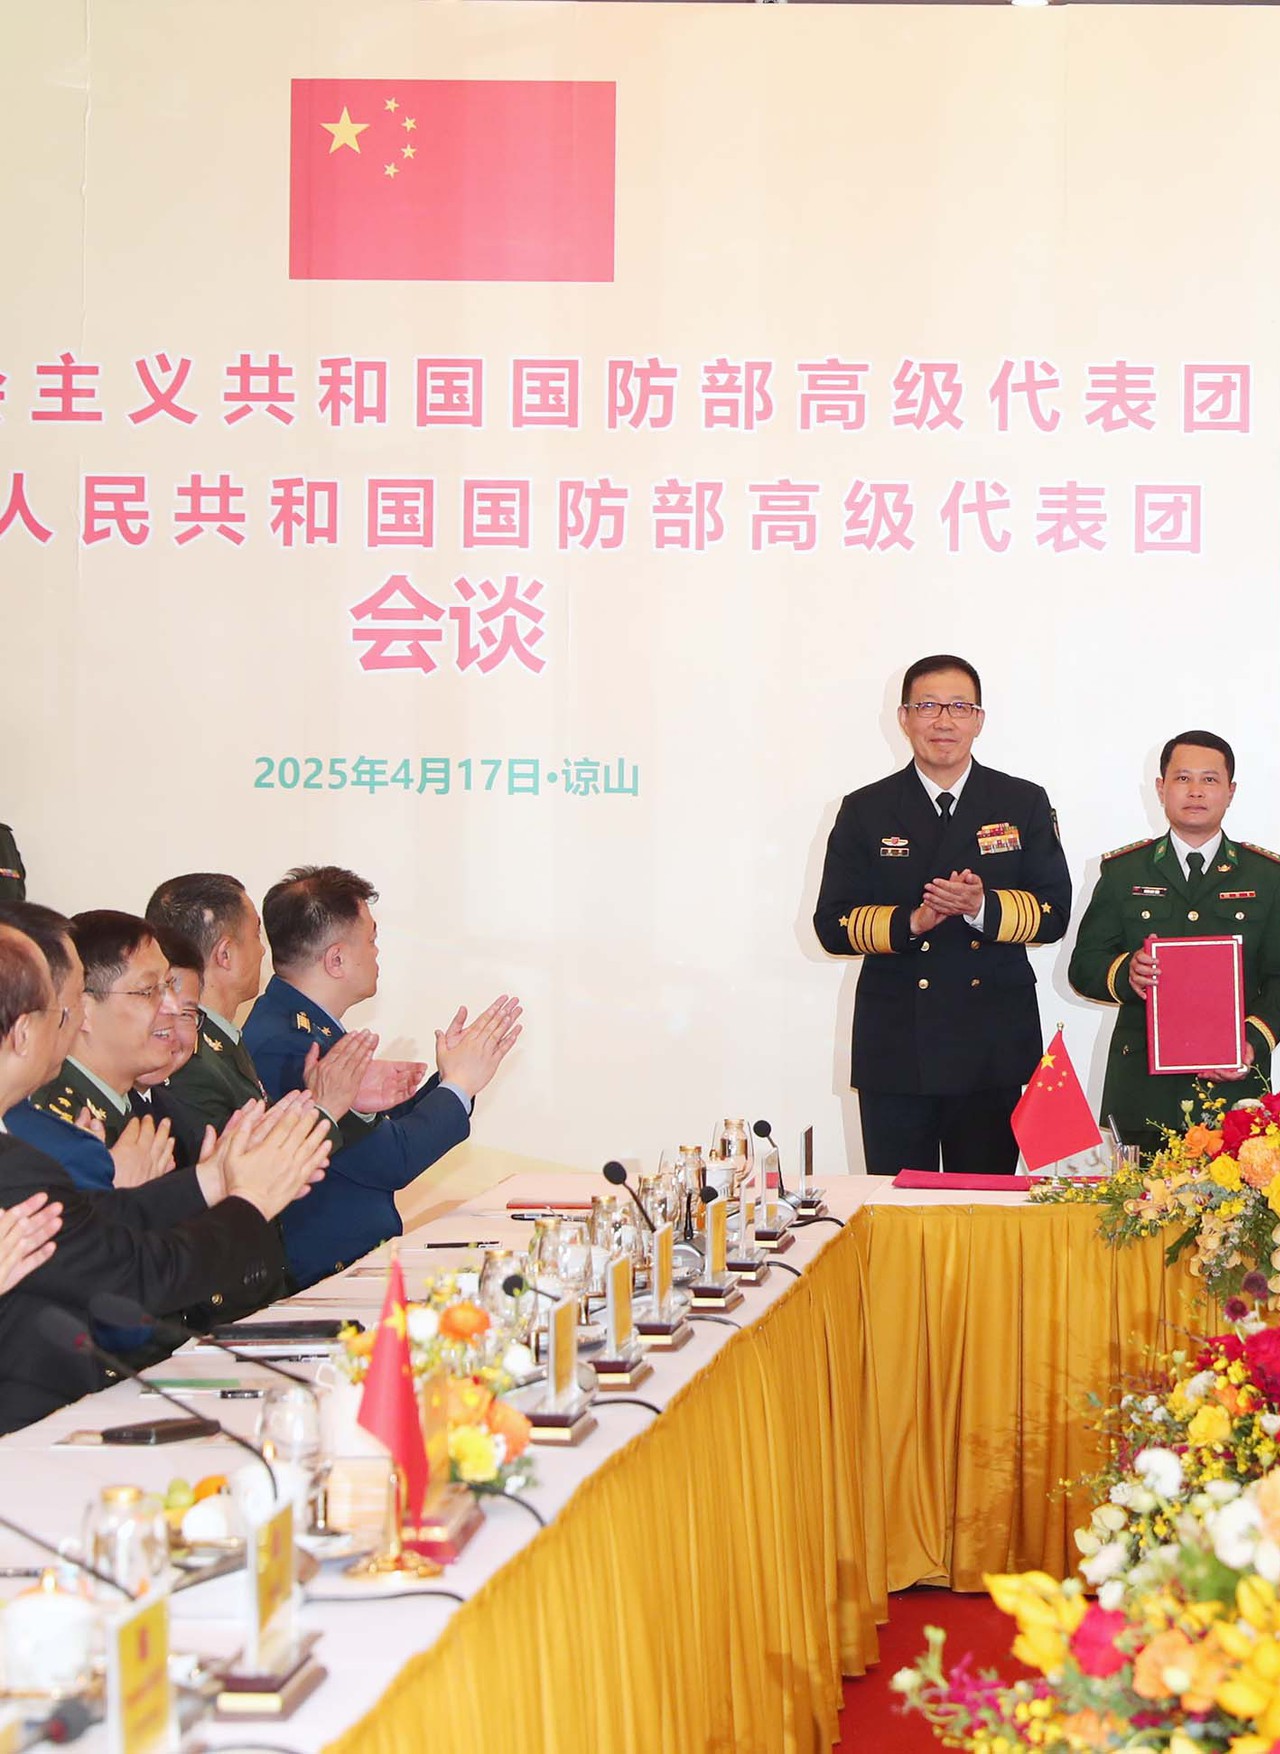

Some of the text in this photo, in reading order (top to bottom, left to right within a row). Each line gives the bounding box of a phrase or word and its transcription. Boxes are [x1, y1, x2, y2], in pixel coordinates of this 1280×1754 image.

[0, 352, 1250, 433] 主义共和国国防部高级代表团
[349, 574, 547, 674] 会谈
